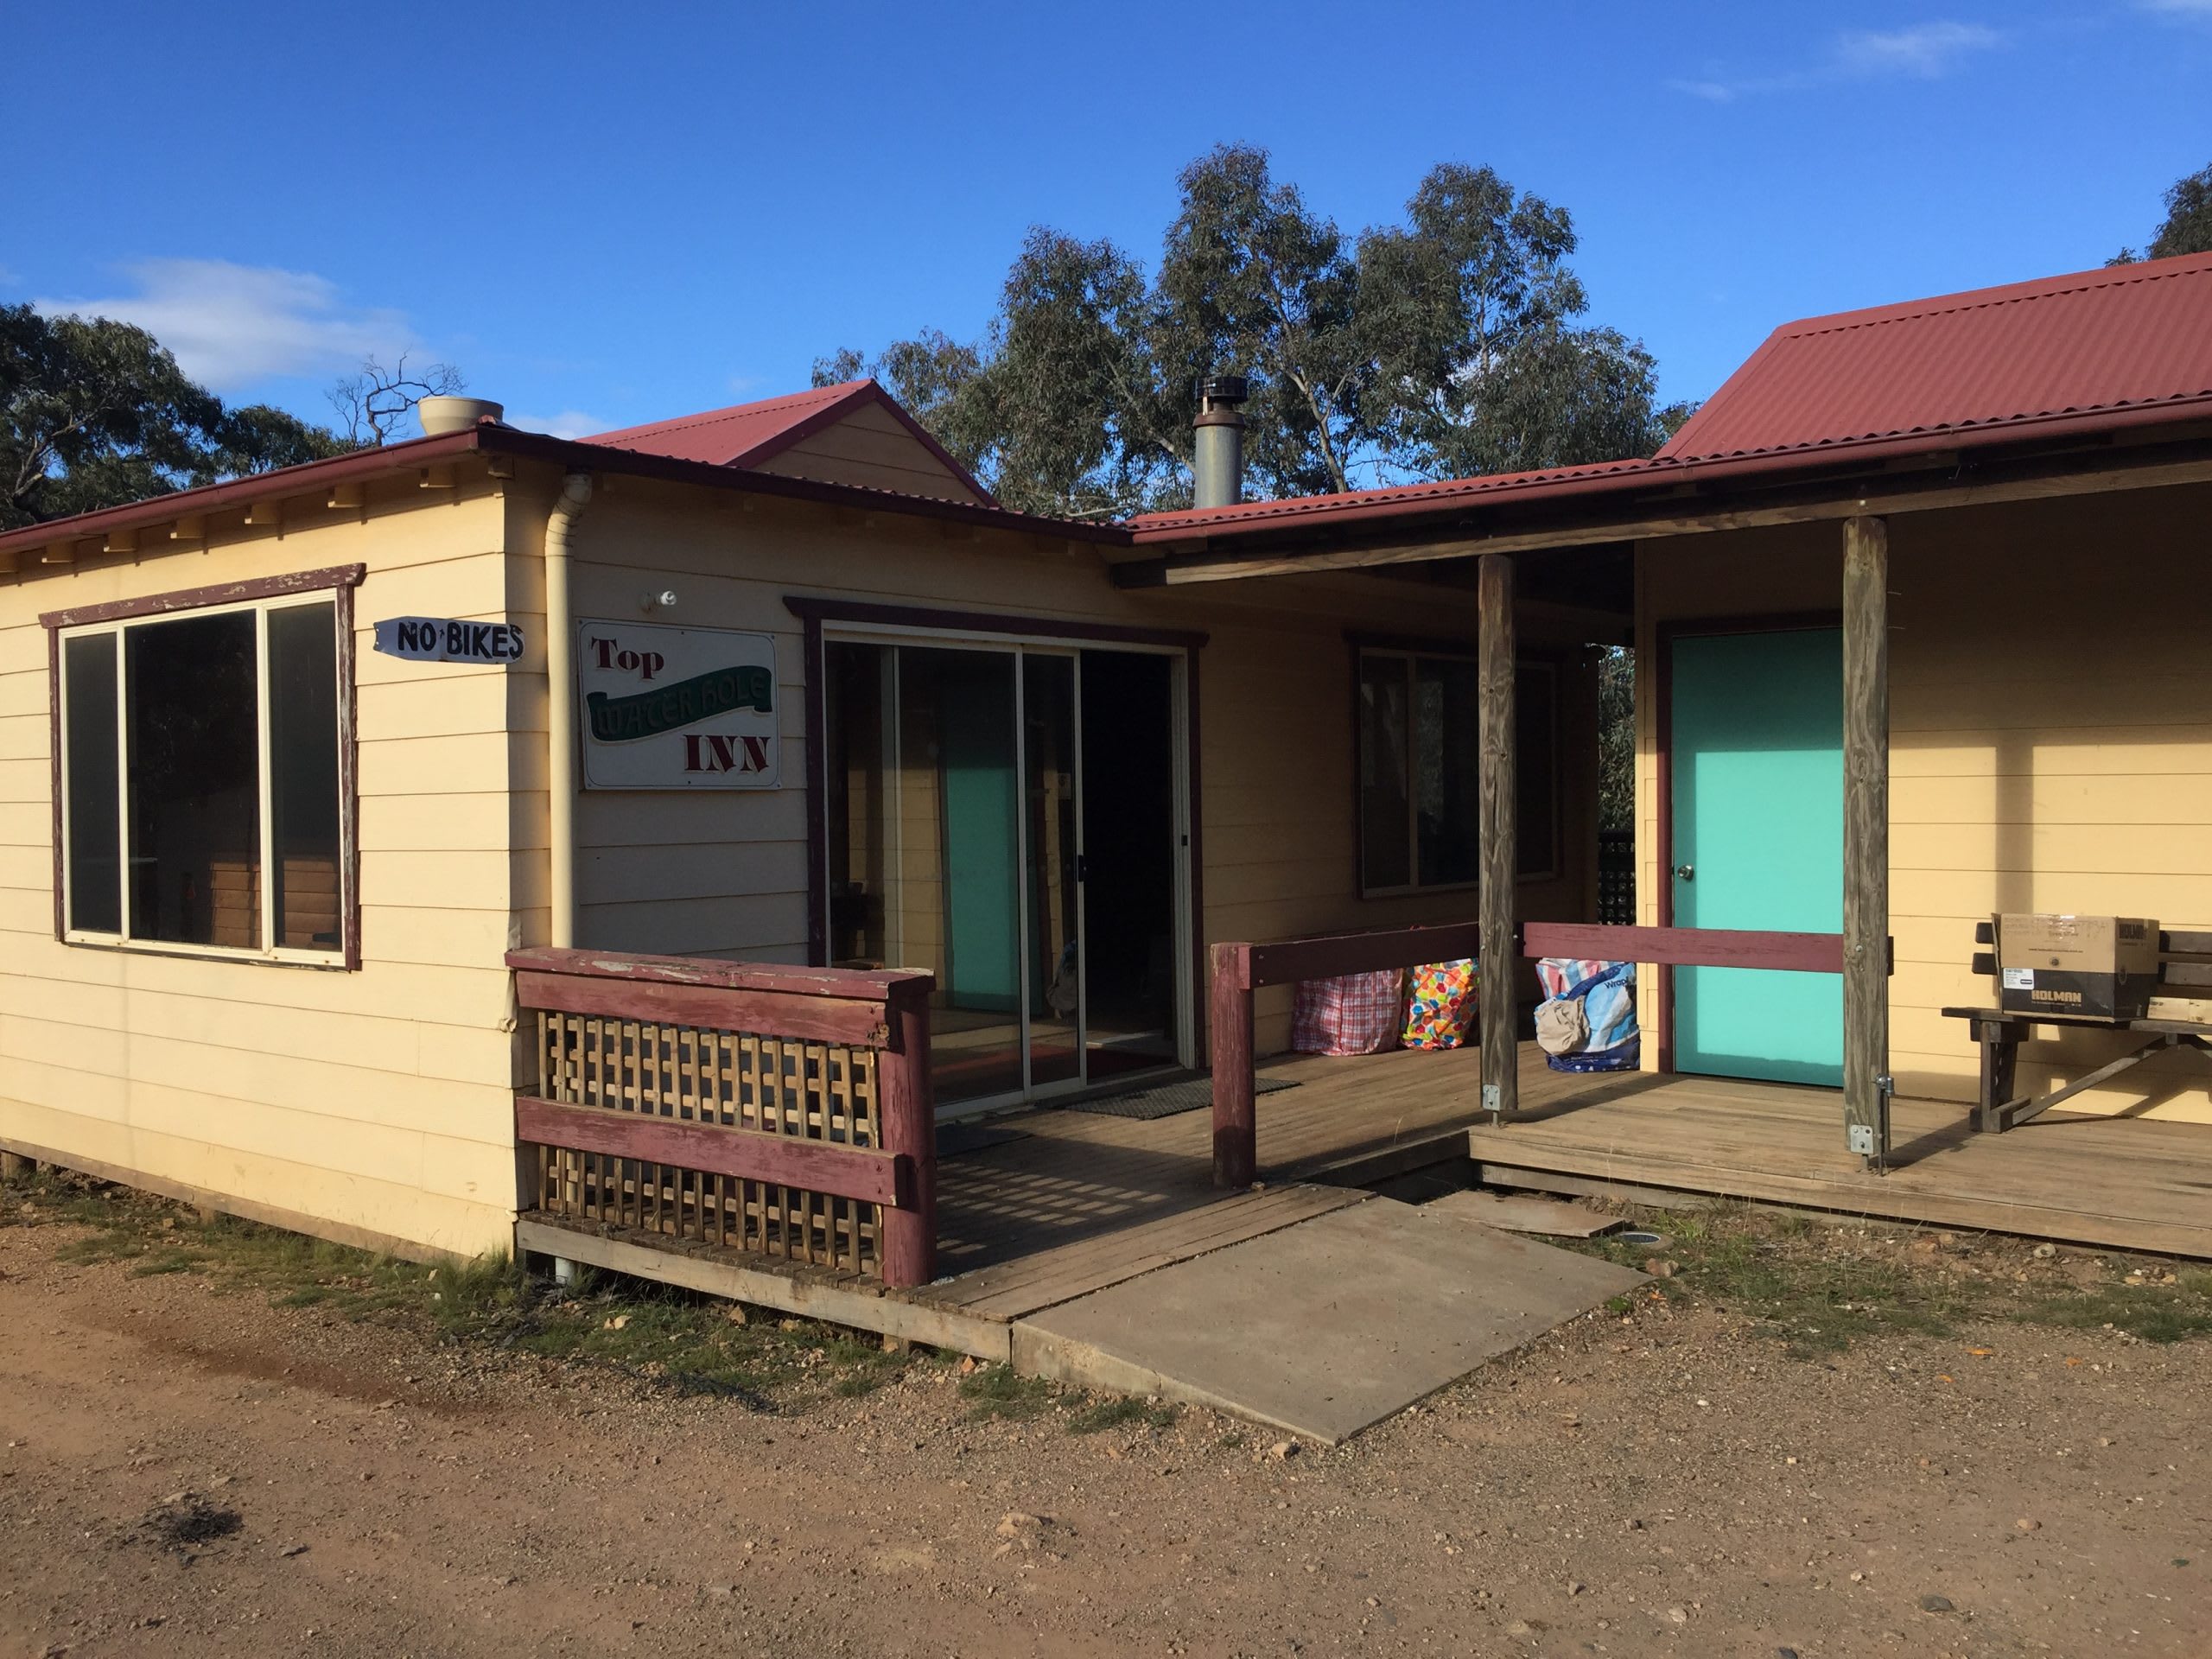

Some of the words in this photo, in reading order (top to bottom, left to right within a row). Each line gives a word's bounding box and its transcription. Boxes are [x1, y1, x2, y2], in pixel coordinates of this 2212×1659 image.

[398, 621, 436, 652] NO
[447, 621, 524, 659] BIKES
[591, 637, 664, 679] Top
[683, 734, 771, 773] INN
[2031, 989, 2082, 1003] HOLMAN
